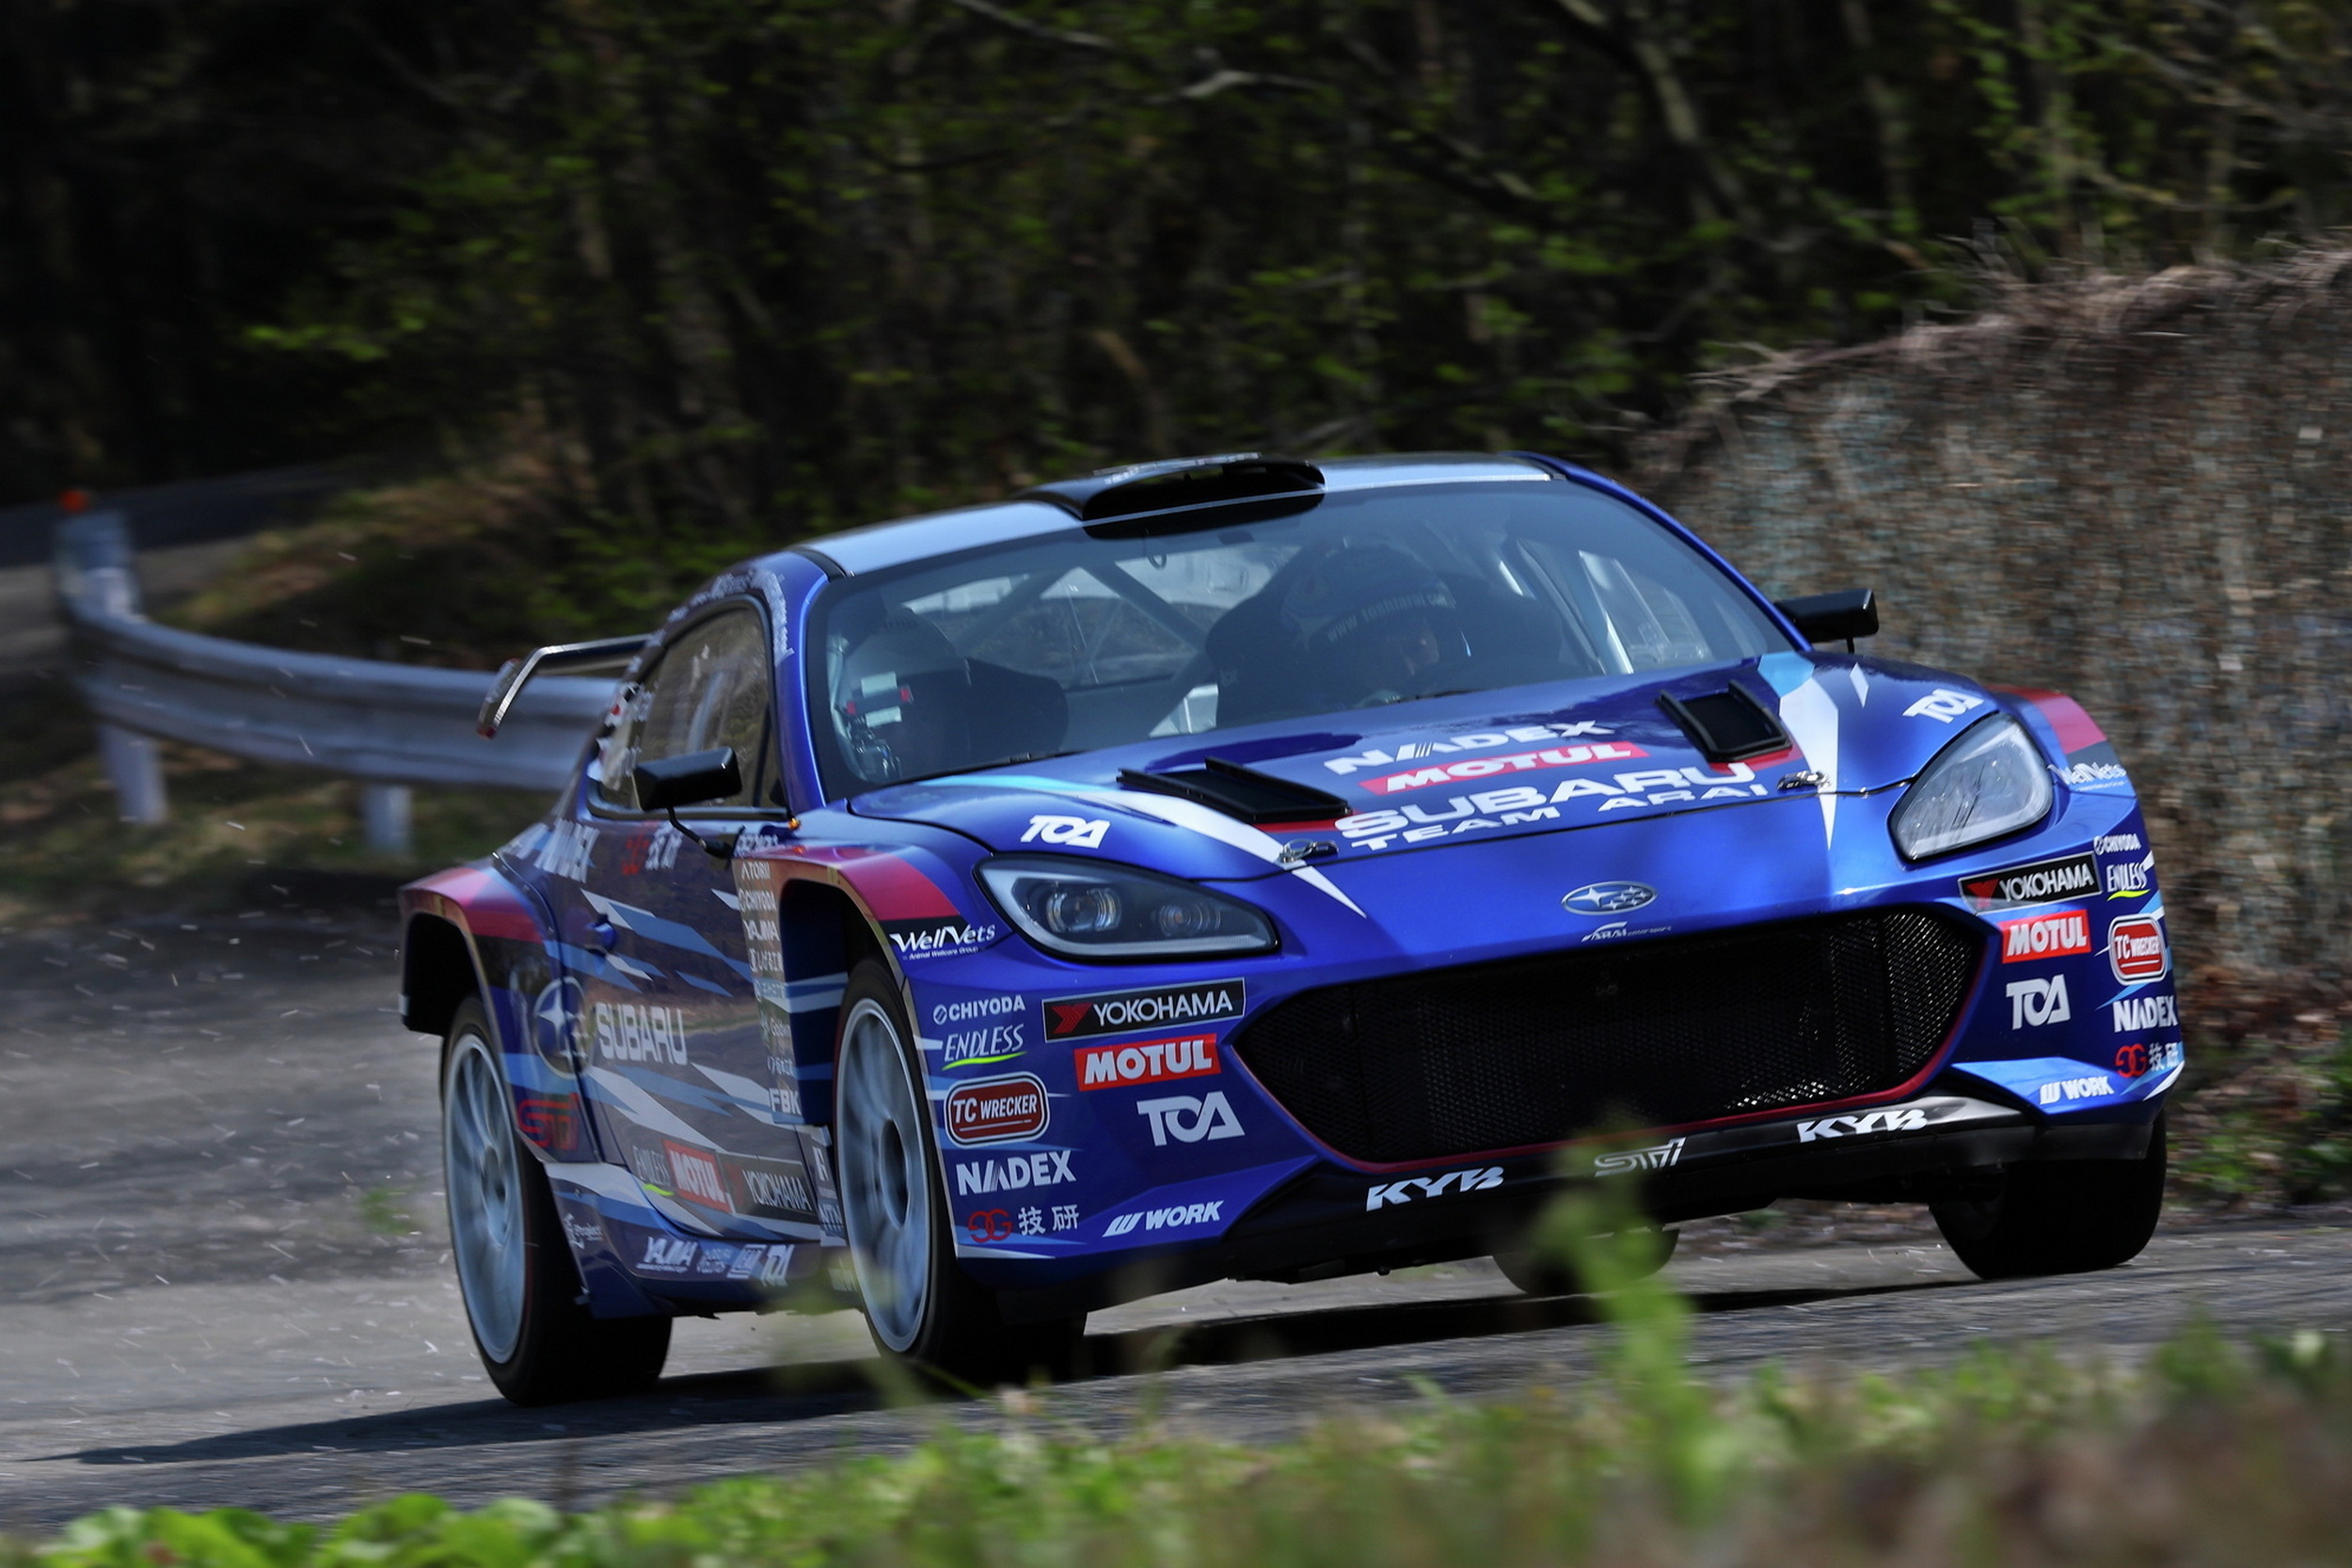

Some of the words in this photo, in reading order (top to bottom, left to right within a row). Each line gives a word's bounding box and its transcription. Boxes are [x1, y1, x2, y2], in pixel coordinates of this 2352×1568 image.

[1902, 689, 1984, 723] TOA
[1324, 721, 1615, 776] NADEX
[1386, 743, 1632, 793] MOTUL
[1335, 762, 1757, 838] SUBARU
[1352, 806, 1562, 851] TEAM
[1597, 784, 1770, 813] ARAI
[1020, 815, 1111, 848] TOA
[1999, 863, 2095, 902] YOKOHAMA
[2106, 860, 2148, 894] ENDLESS
[2007, 915, 2088, 958] MOTUL
[2115, 934, 2131, 958] TC
[948, 994, 1026, 1021] CHIYODA
[1094, 989, 1233, 1028] YOKOHAMA
[2006, 974, 2072, 1030] TOA
[2112, 994, 2179, 1034] NADEX
[596, 1002, 688, 1066] SUBARU
[944, 1023, 1024, 1063] ENDLESS
[1084, 1040, 1214, 1085] MOTUL
[769, 1087, 803, 1117] FBK
[2061, 1074, 2115, 1101] WORK
[953, 1096, 977, 1124] TC
[979, 1094, 1039, 1119] WRECKER
[1136, 1091, 1245, 1147] TOA
[1798, 1108, 1928, 1144] KYB
[668, 1149, 732, 1206] MOTUL
[742, 1169, 813, 1213] YOKOHAMA
[956, 1149, 1077, 1196] NADEX
[1366, 1165, 1504, 1212] KYB
[1145, 1201, 1224, 1230] WORK
